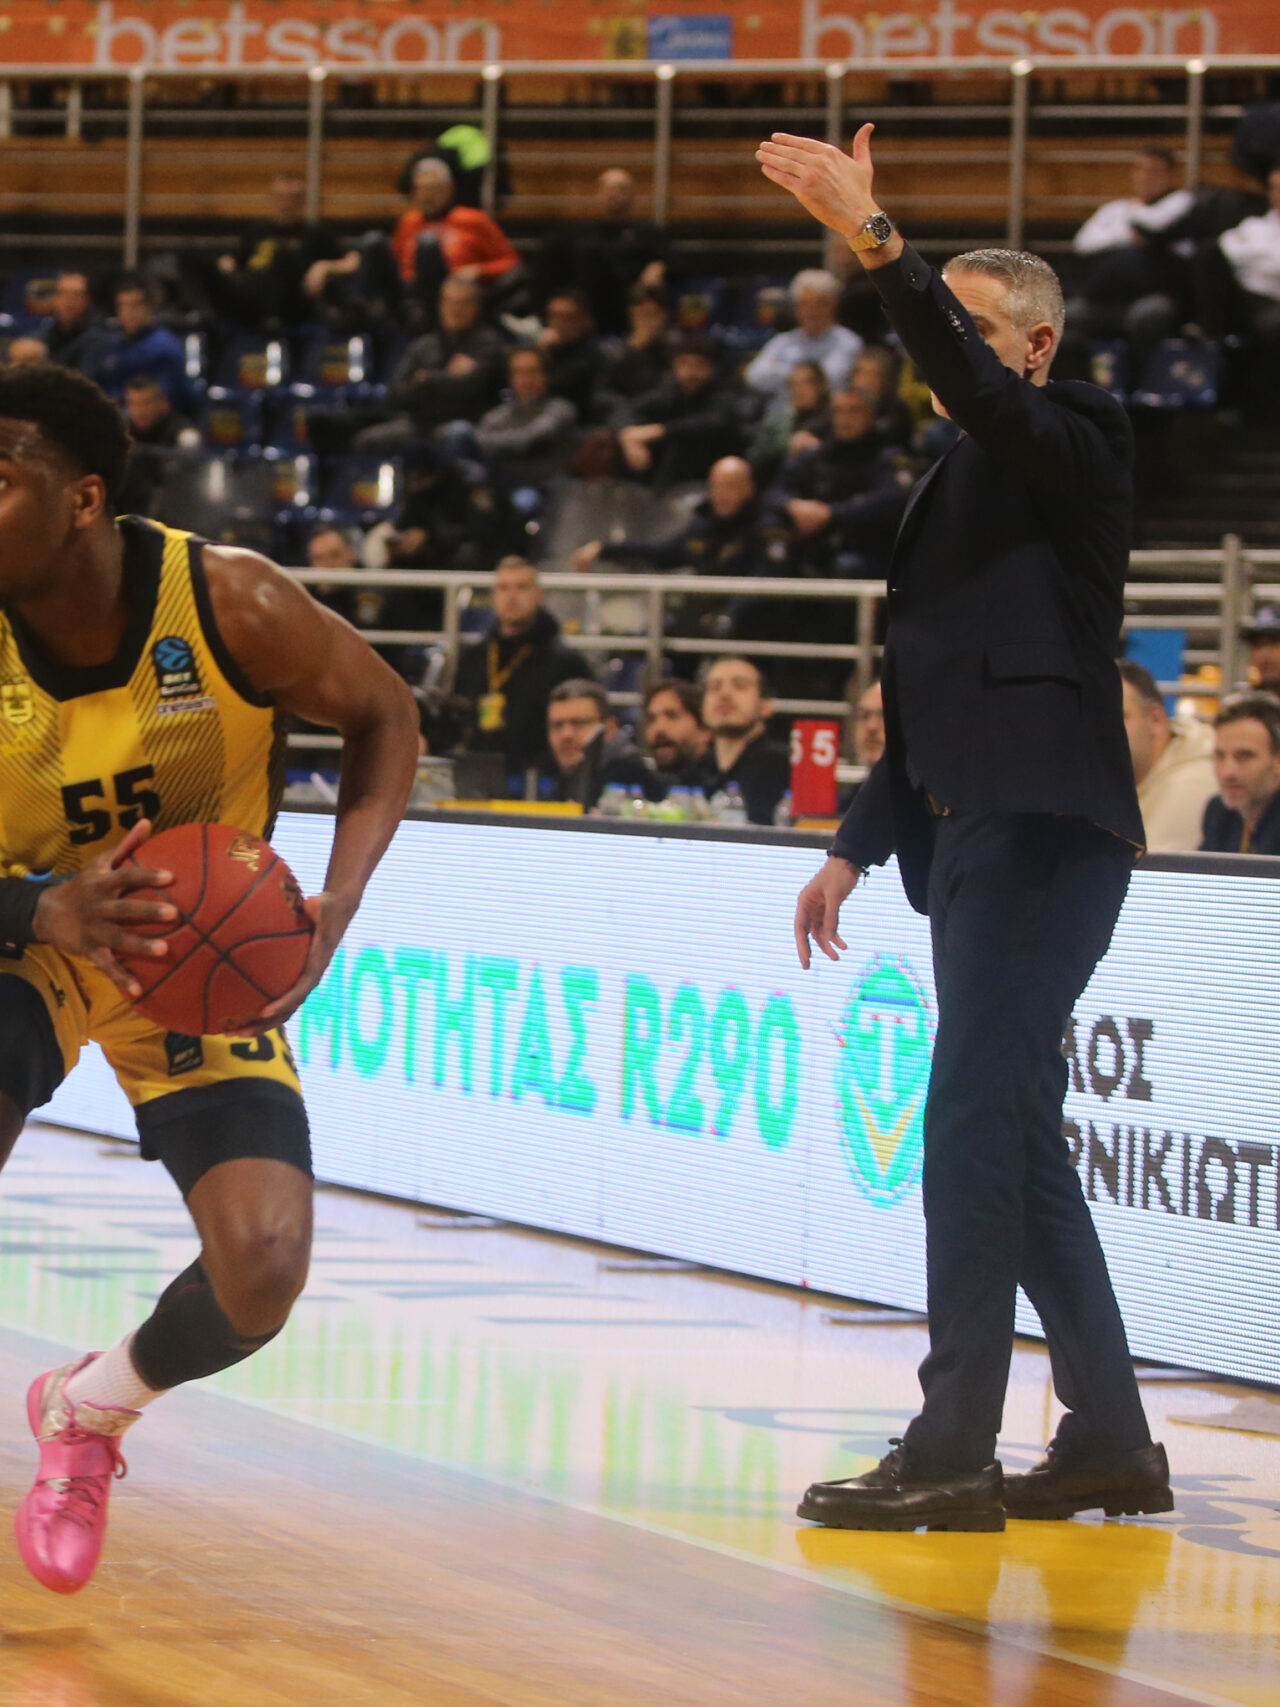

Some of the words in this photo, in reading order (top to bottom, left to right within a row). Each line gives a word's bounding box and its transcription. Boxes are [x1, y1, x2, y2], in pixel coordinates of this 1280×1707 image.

[94, 1, 501, 66] betsson
[800, 0, 1218, 58] betsson
[62, 765, 161, 844] 55
[618, 972, 804, 1153] R290
